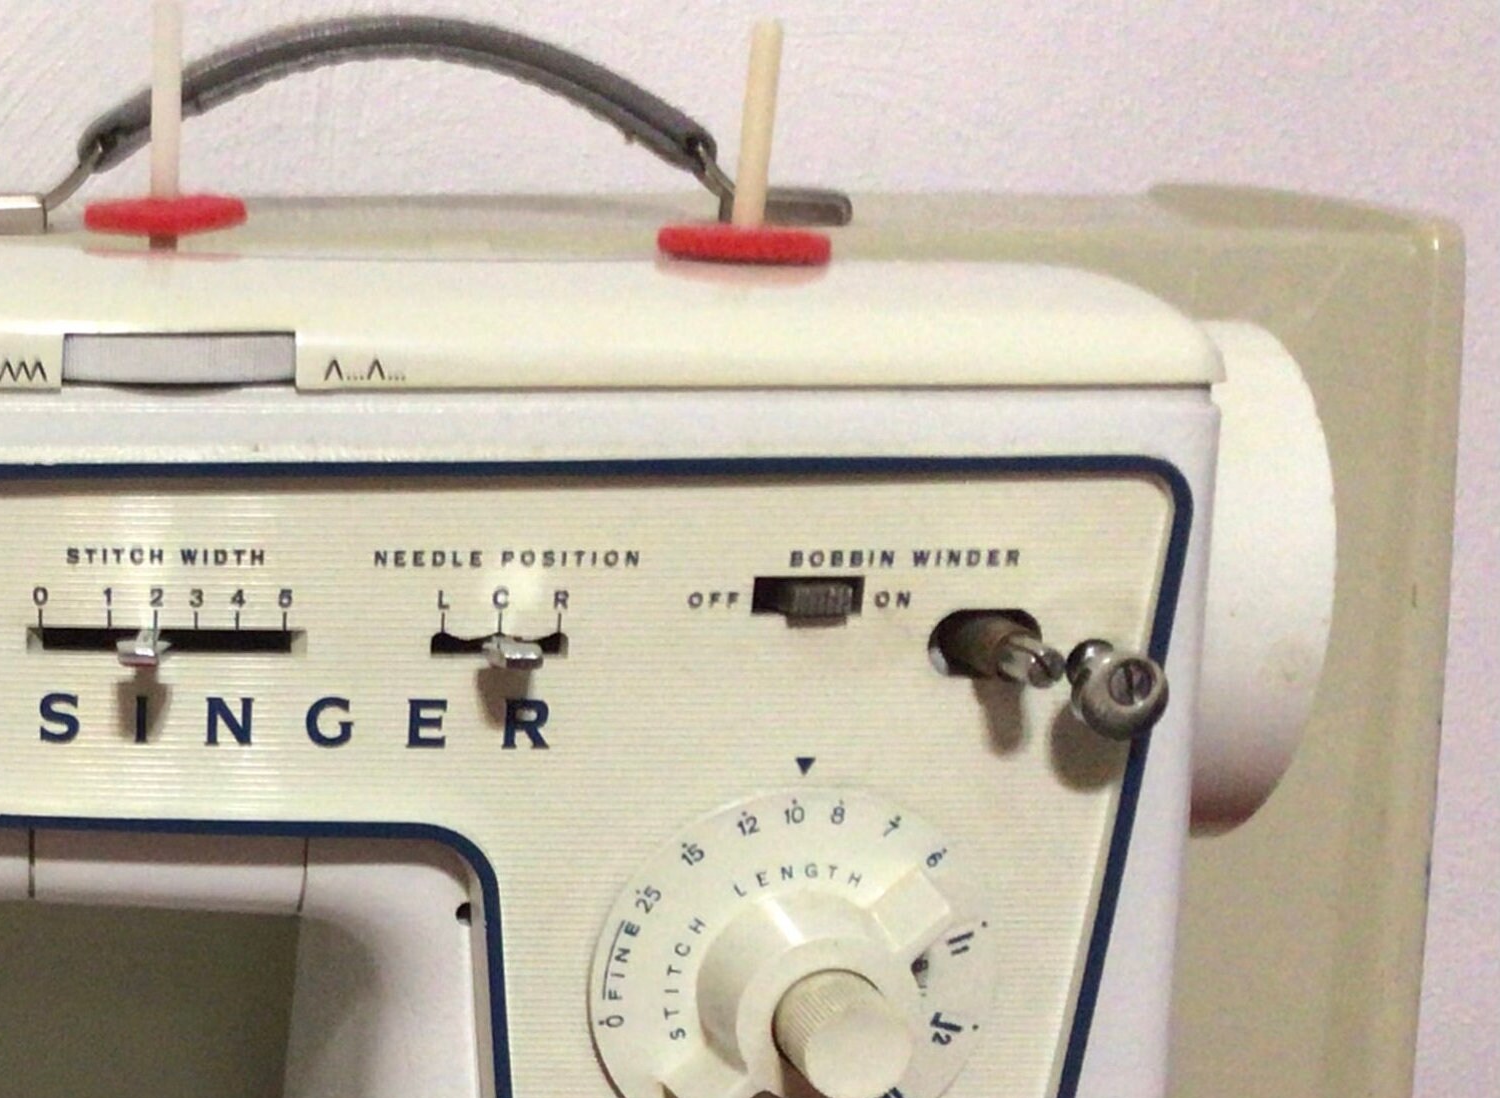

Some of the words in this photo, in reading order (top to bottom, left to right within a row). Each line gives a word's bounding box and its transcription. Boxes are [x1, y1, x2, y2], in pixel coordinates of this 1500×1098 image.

[66, 547, 164, 565] STITCH
[181, 548, 265, 566] WIDTH
[374, 550, 483, 567] NEEDLE
[501, 550, 639, 567] POSITION
[789, 550, 895, 568] BOBBIN
[913, 549, 1021, 567] WINDER
[33, 586, 48, 606] 0
[103, 588, 113, 606] 1
[150, 588, 164, 607] 2
[189, 589, 204, 608] 3
[231, 589, 246, 608] 4
[278, 589, 293, 608] 5
[437, 590, 450, 609] L
[492, 587, 510, 609] C
[553, 591, 570, 609] R
[688, 591, 740, 609] OFF
[874, 591, 911, 609] ON
[38, 692, 550, 750] SINGER
[736, 815, 761, 837] 12
[784, 806, 806, 824] 10
[830, 805, 846, 825] 8
[681, 842, 706, 867] 15
[635, 885, 663, 913] 25
[608, 921, 641, 1001] FINE
[663, 917, 706, 1041] STITCH
[733, 863, 862, 898] LENGTH
